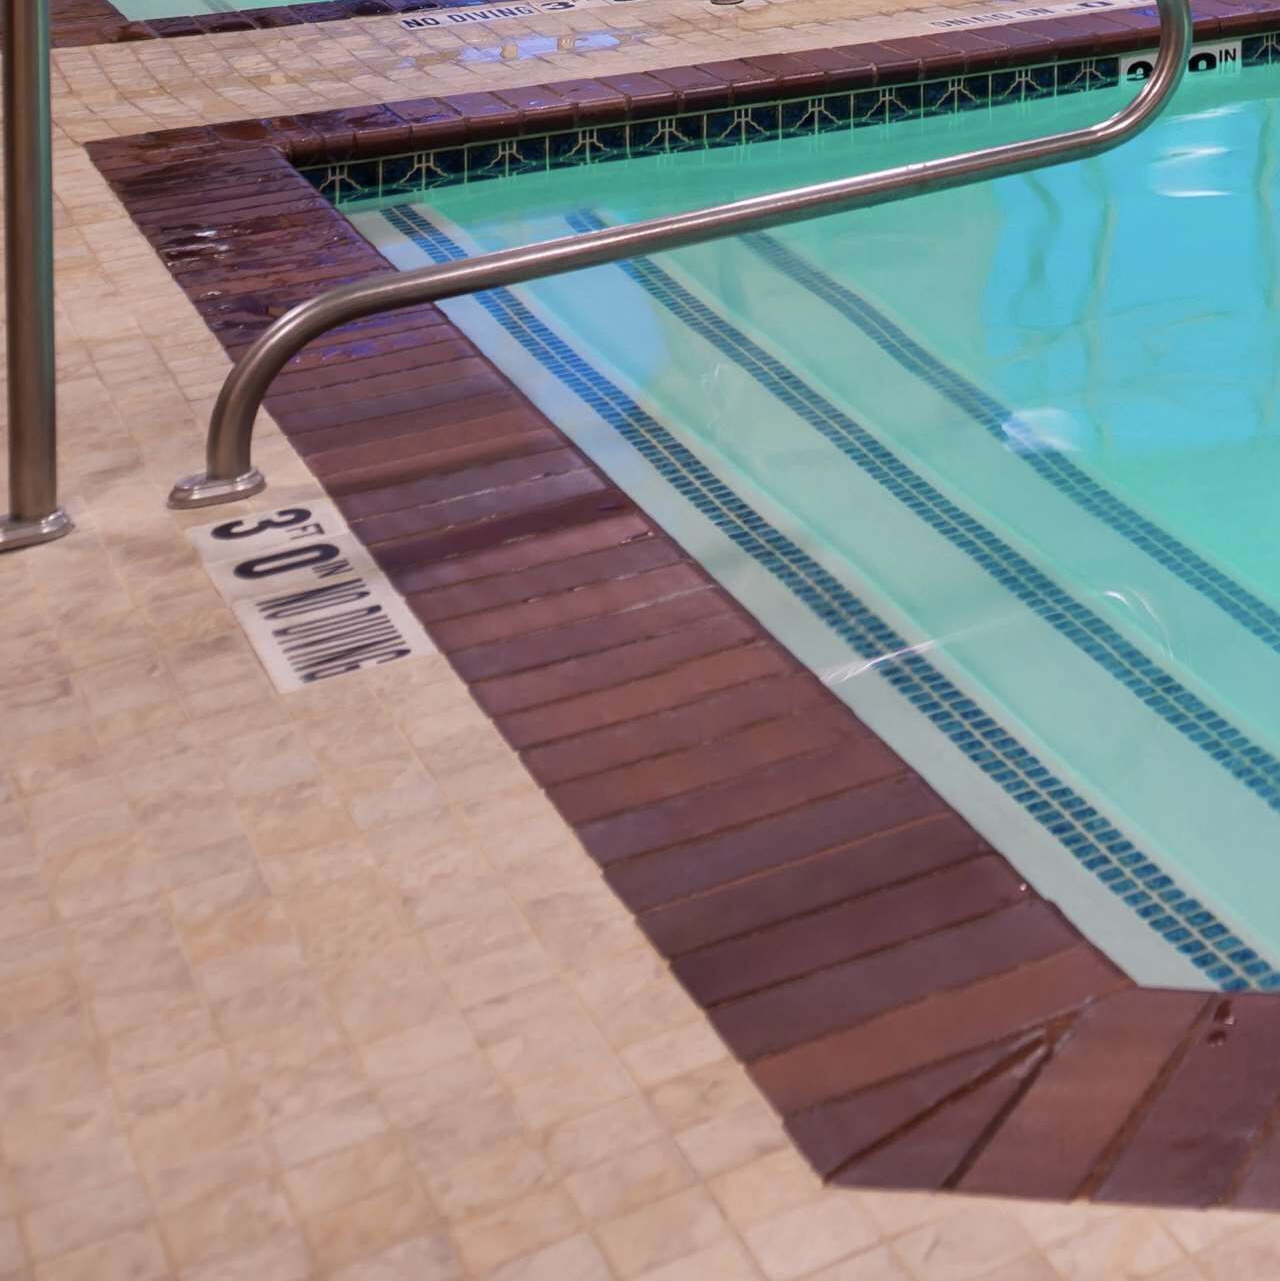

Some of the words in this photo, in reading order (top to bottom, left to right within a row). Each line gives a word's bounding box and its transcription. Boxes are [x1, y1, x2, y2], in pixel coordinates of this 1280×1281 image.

[401, 17, 440, 28] NO
[447, 6, 535, 23] DIVING
[1219, 48, 1237, 64] IN
[210, 507, 312, 540] 3
[285, 522, 326, 541] FT
[233, 543, 340, 580] 0
[312, 559, 354, 580] IN
[256, 578, 371, 620] NO
[271, 604, 412, 684] DIVING
